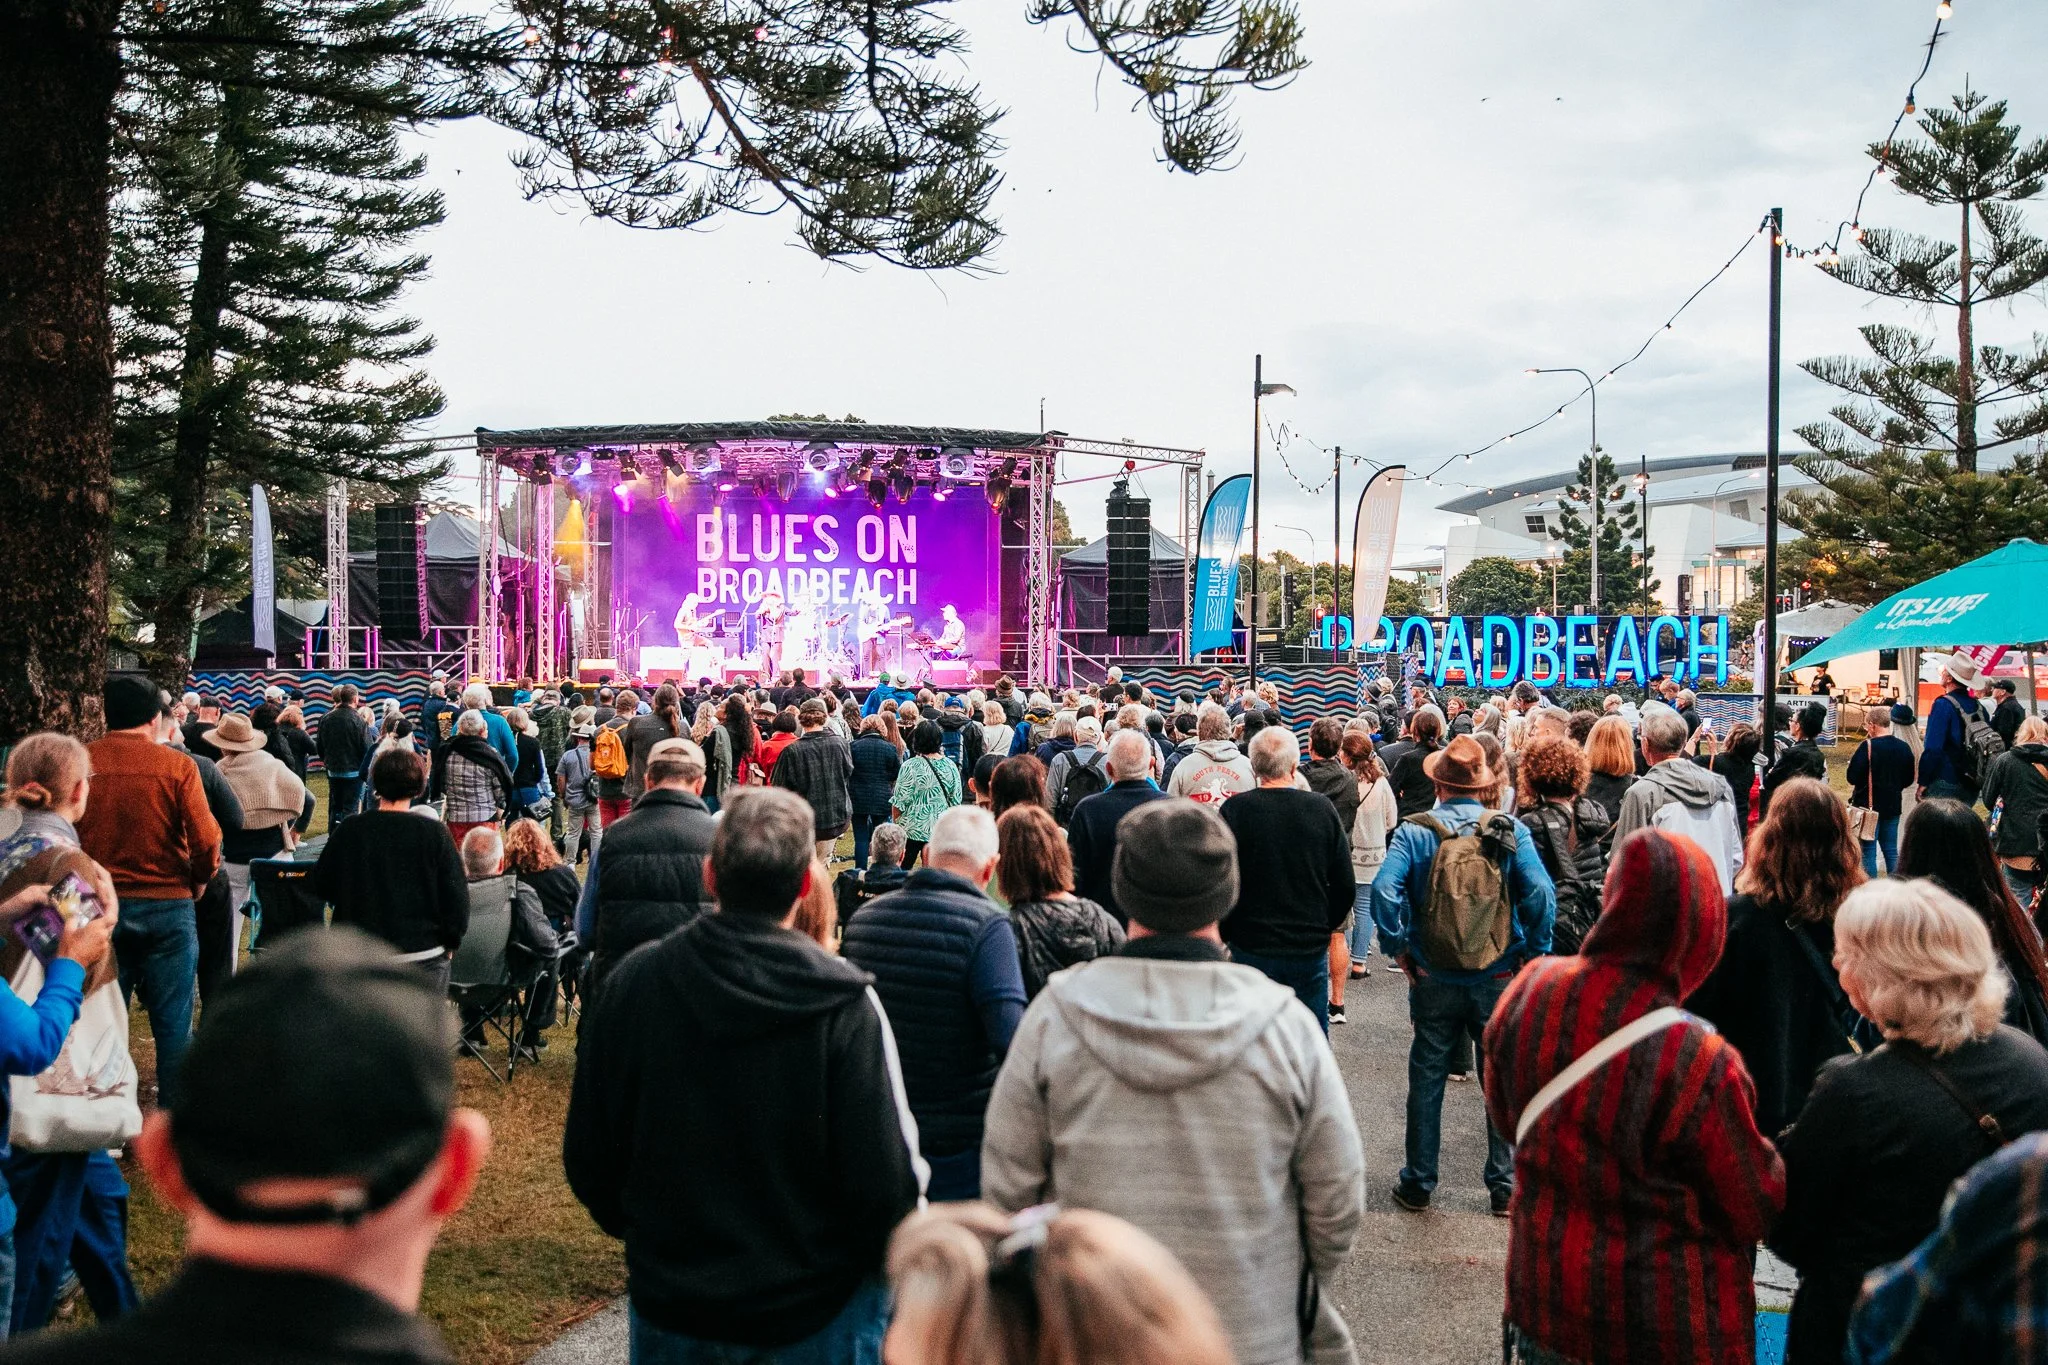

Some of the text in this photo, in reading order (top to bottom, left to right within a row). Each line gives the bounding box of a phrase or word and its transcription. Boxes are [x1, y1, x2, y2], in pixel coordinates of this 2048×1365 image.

[697, 513, 917, 564] BLUES ON
[697, 567, 917, 605] BROADBEACH
[1208, 560, 1222, 597] BLUES
[1192, 765, 1241, 782] SOUTH PERTH
